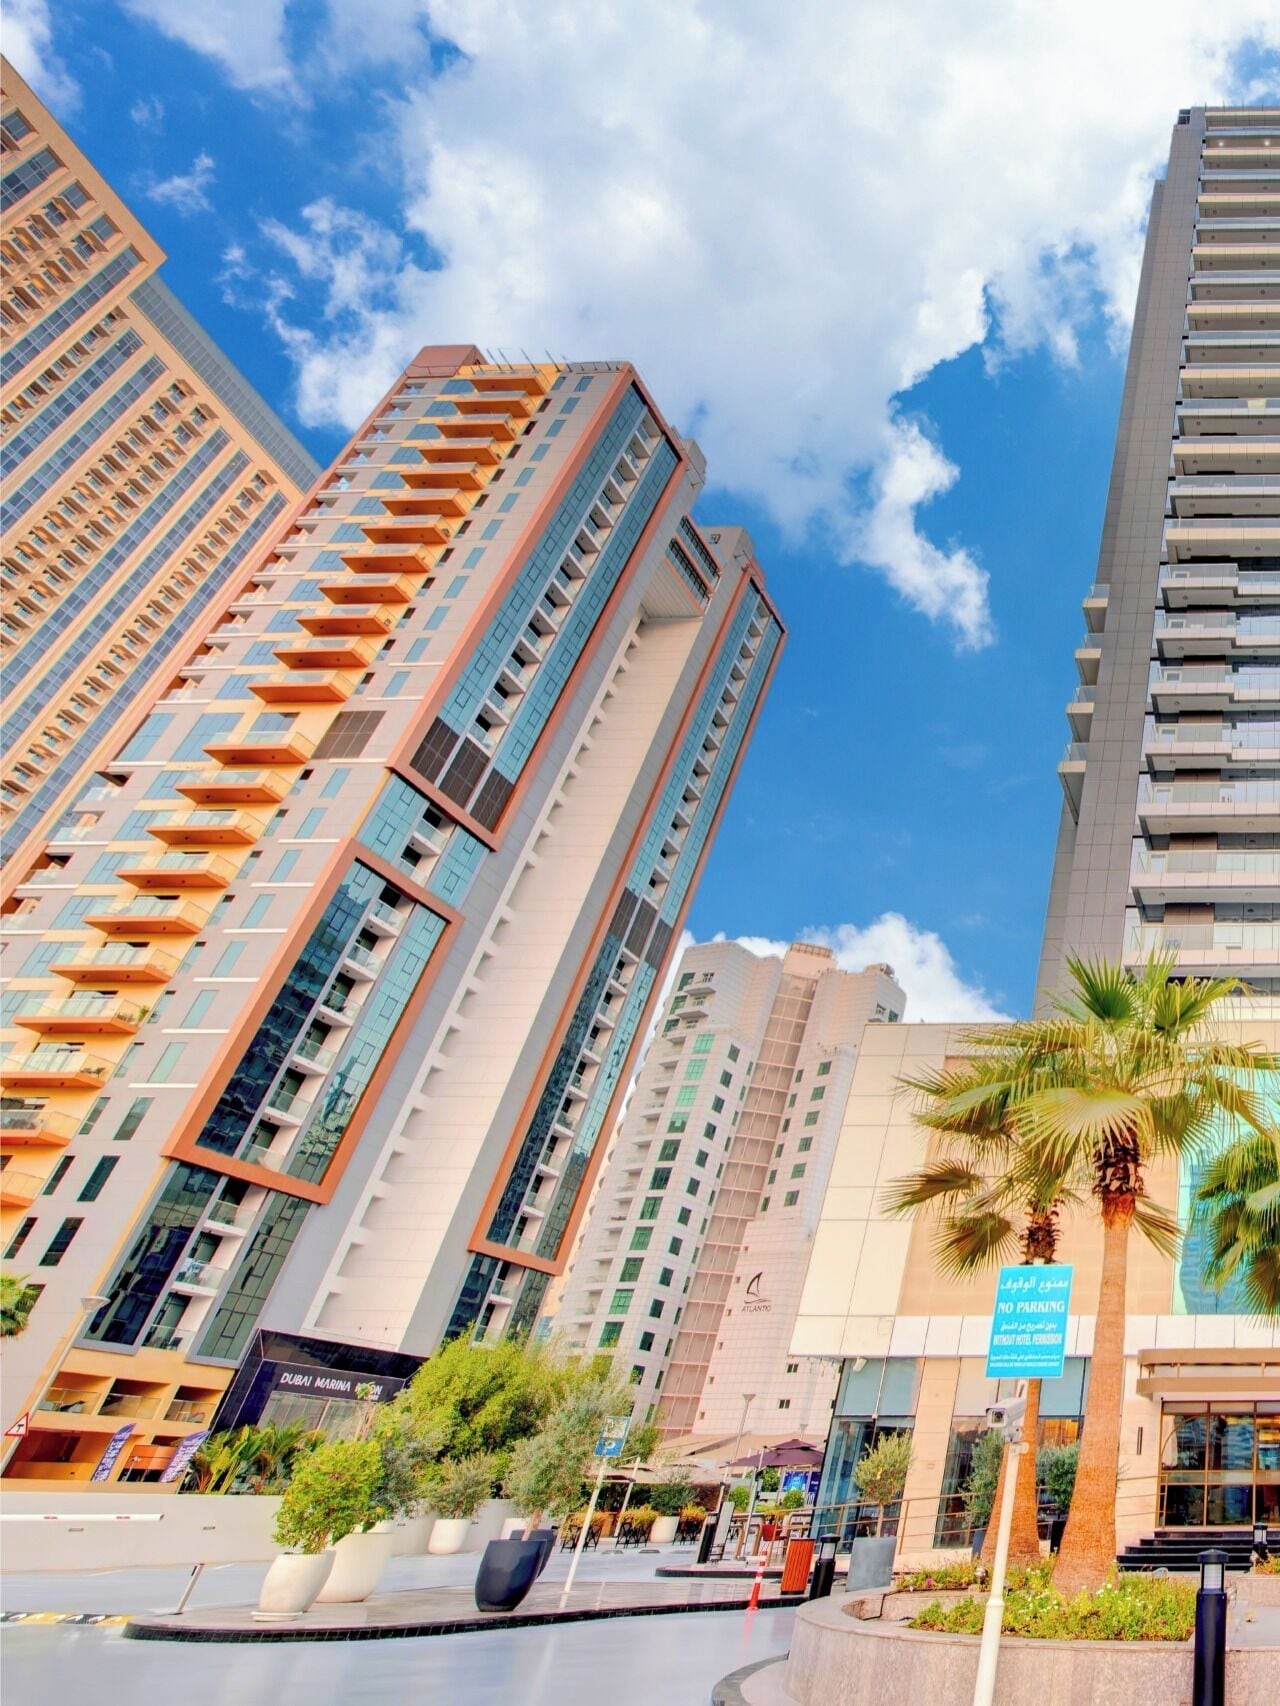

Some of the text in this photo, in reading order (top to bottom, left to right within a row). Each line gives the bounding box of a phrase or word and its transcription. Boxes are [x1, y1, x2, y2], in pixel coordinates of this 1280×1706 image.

[1000, 1276, 1068, 1292] ممنوع الوقوف
[998, 1301, 1064, 1313] NO PARKING
[1015, 1334, 1031, 1345] HOTEL
[280, 1373, 312, 1386] DUBAI
[315, 1378, 351, 1391] MARINA
